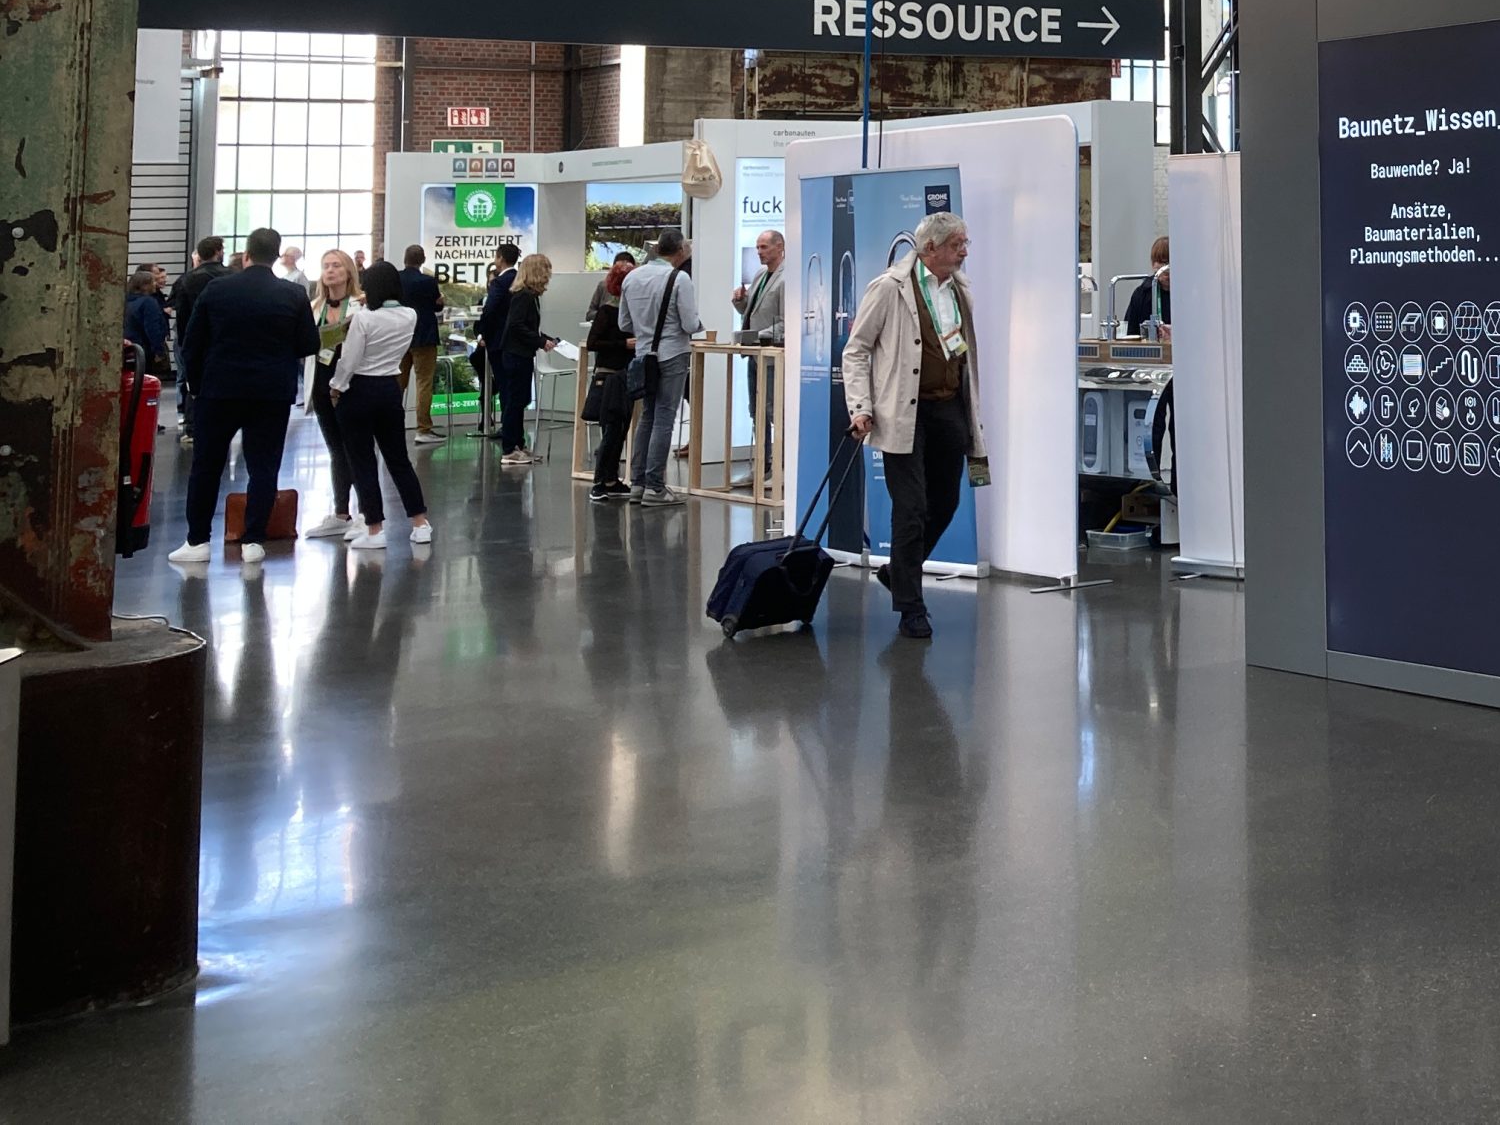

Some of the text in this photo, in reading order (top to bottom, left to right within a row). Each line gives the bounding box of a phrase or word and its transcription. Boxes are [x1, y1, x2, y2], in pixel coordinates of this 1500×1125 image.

[773, 129, 816, 137] carbonauten
[1370, 157, 1471, 179] Bauwende? Ja!
[743, 196, 783, 214] fuck
[1390, 202, 1451, 220] Ansätze,
[435, 235, 522, 247] ZERTIFIZIERT
[1364, 223, 1481, 242] Baumaterialien,
[1350, 245, 1499, 267] Planungsmethoden...
